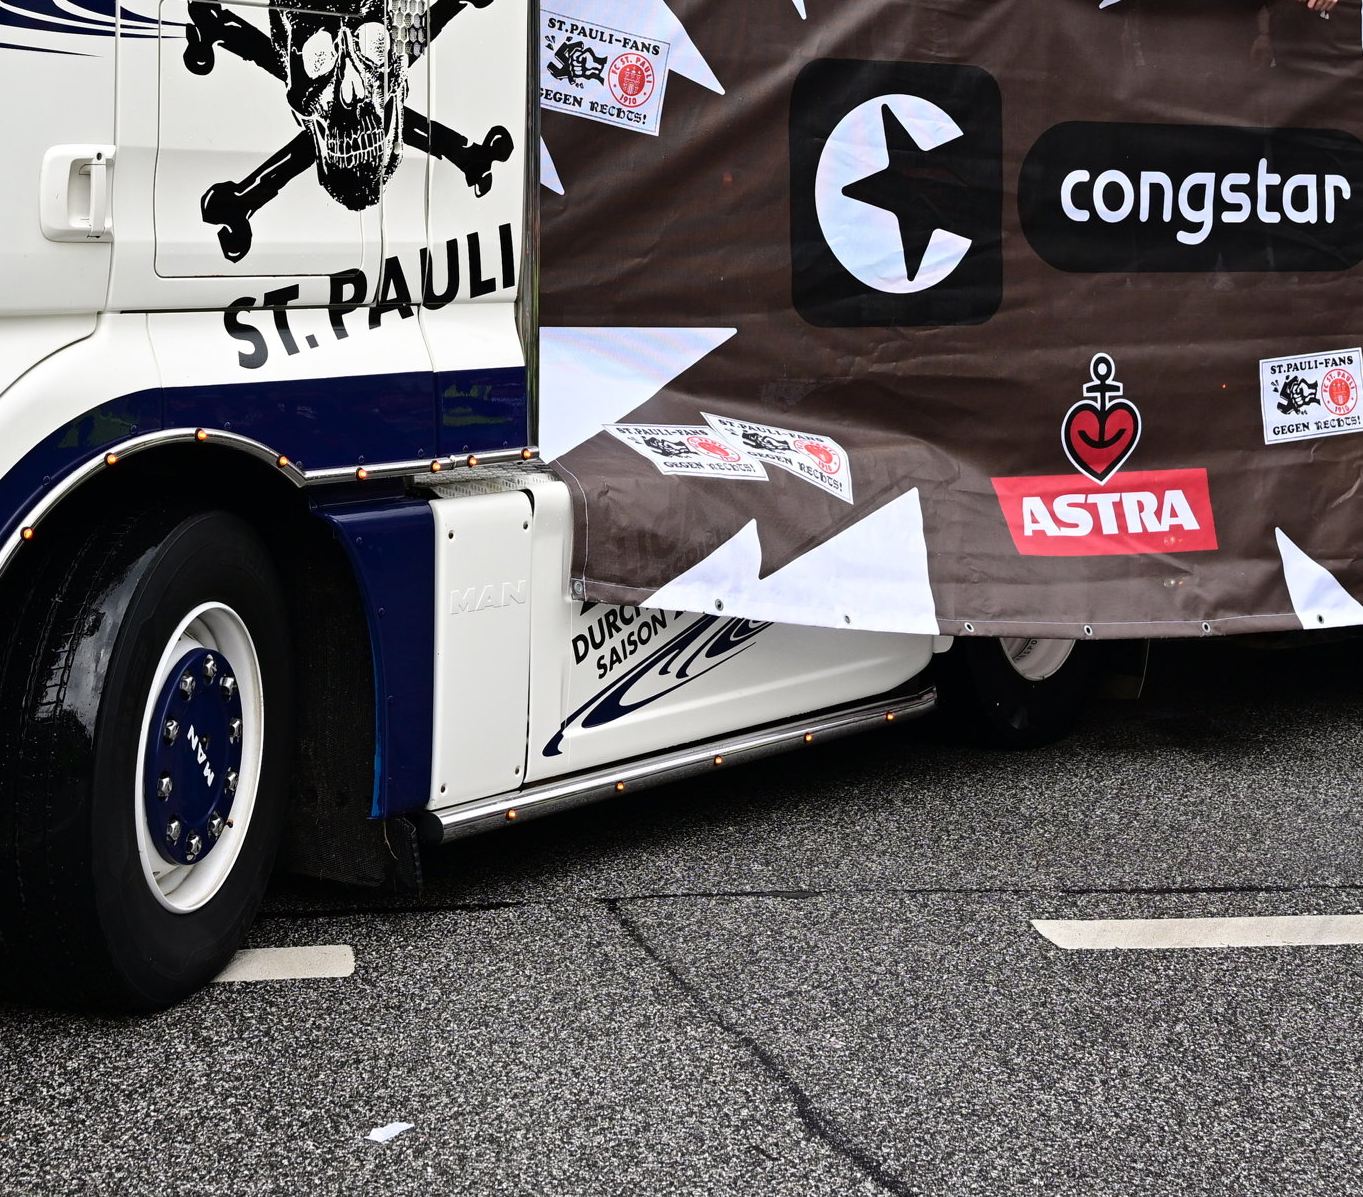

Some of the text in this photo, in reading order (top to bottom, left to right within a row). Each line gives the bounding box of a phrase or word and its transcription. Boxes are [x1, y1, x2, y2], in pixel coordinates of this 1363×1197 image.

[548, 17, 660, 56] ST.PAULI-FANS
[611, 64, 621, 75] FC
[635, 57, 652, 84] PAULI
[619, 94, 637, 105] 1910
[1060, 157, 1351, 245] congstar
[224, 224, 516, 369] ST. PAULI
[1270, 355, 1354, 375] ST.PAULI-FANS
[1323, 384, 1329, 392] FC
[1337, 370, 1355, 390] PAULI
[1334, 404, 1350, 414] 1910
[616, 426, 709, 436] ST.PAULI-FANS
[717, 418, 825, 443] ST.PAULI-FANS
[1272, 421, 1310, 436] GEGEN
[663, 461, 703, 469] GEGEN
[745, 450, 793, 467] GEGEN
[1022, 490, 1200, 536] ASTRA
[450, 579, 526, 615] MAN
[596, 611, 667, 679] SAISON
[187, 724, 215, 787] MAN
